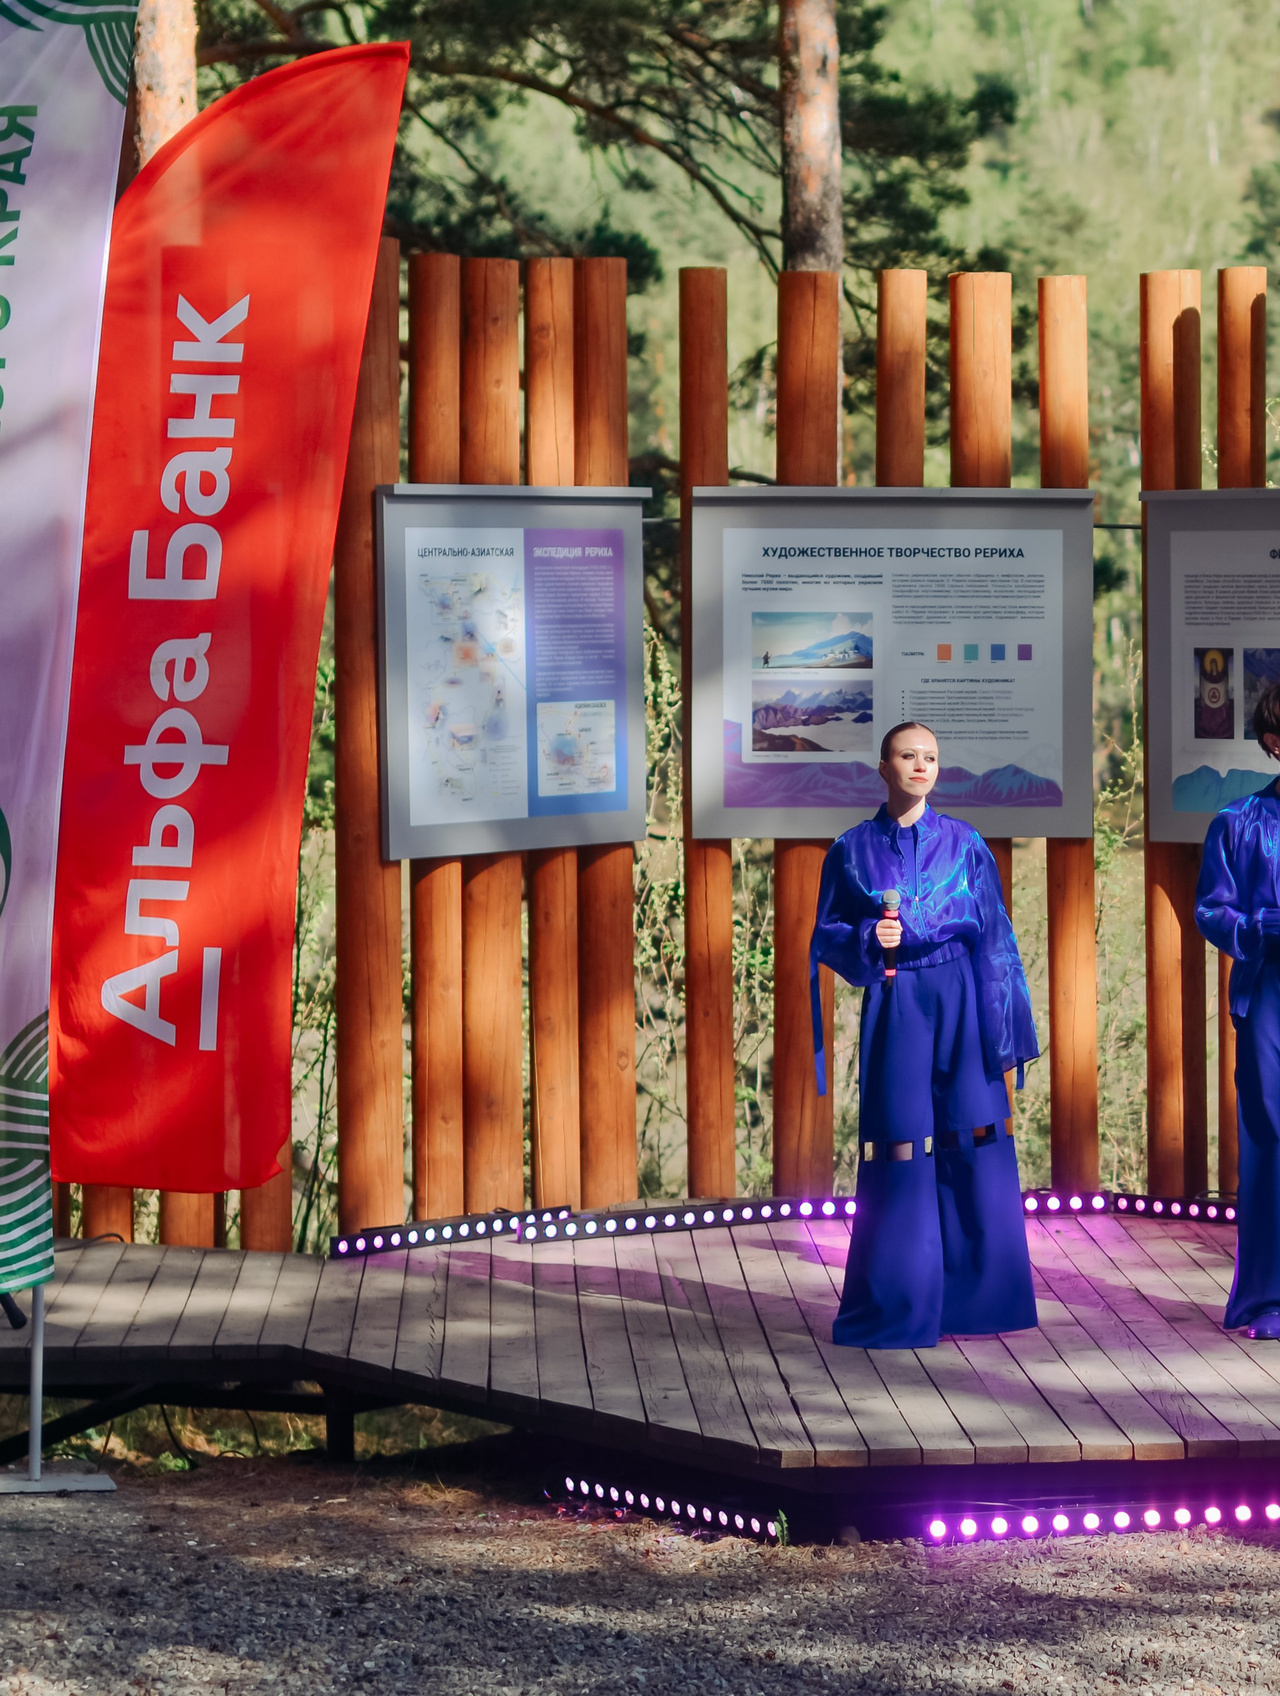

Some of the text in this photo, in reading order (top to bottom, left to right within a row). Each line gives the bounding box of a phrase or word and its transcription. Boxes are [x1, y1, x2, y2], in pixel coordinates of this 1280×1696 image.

[417, 546, 614, 560] ЦЕНТРАЛЬНО-АЗИАТСКАЯ ЭКСПЕДИЦИЯ РЕРИХА
[762, 546, 1025, 560] ХУДОЖЕСТВЕННОЕ ТВОРЧЕСТВО РЕРИХА
[101, 294, 250, 1046] Альфа Банк
